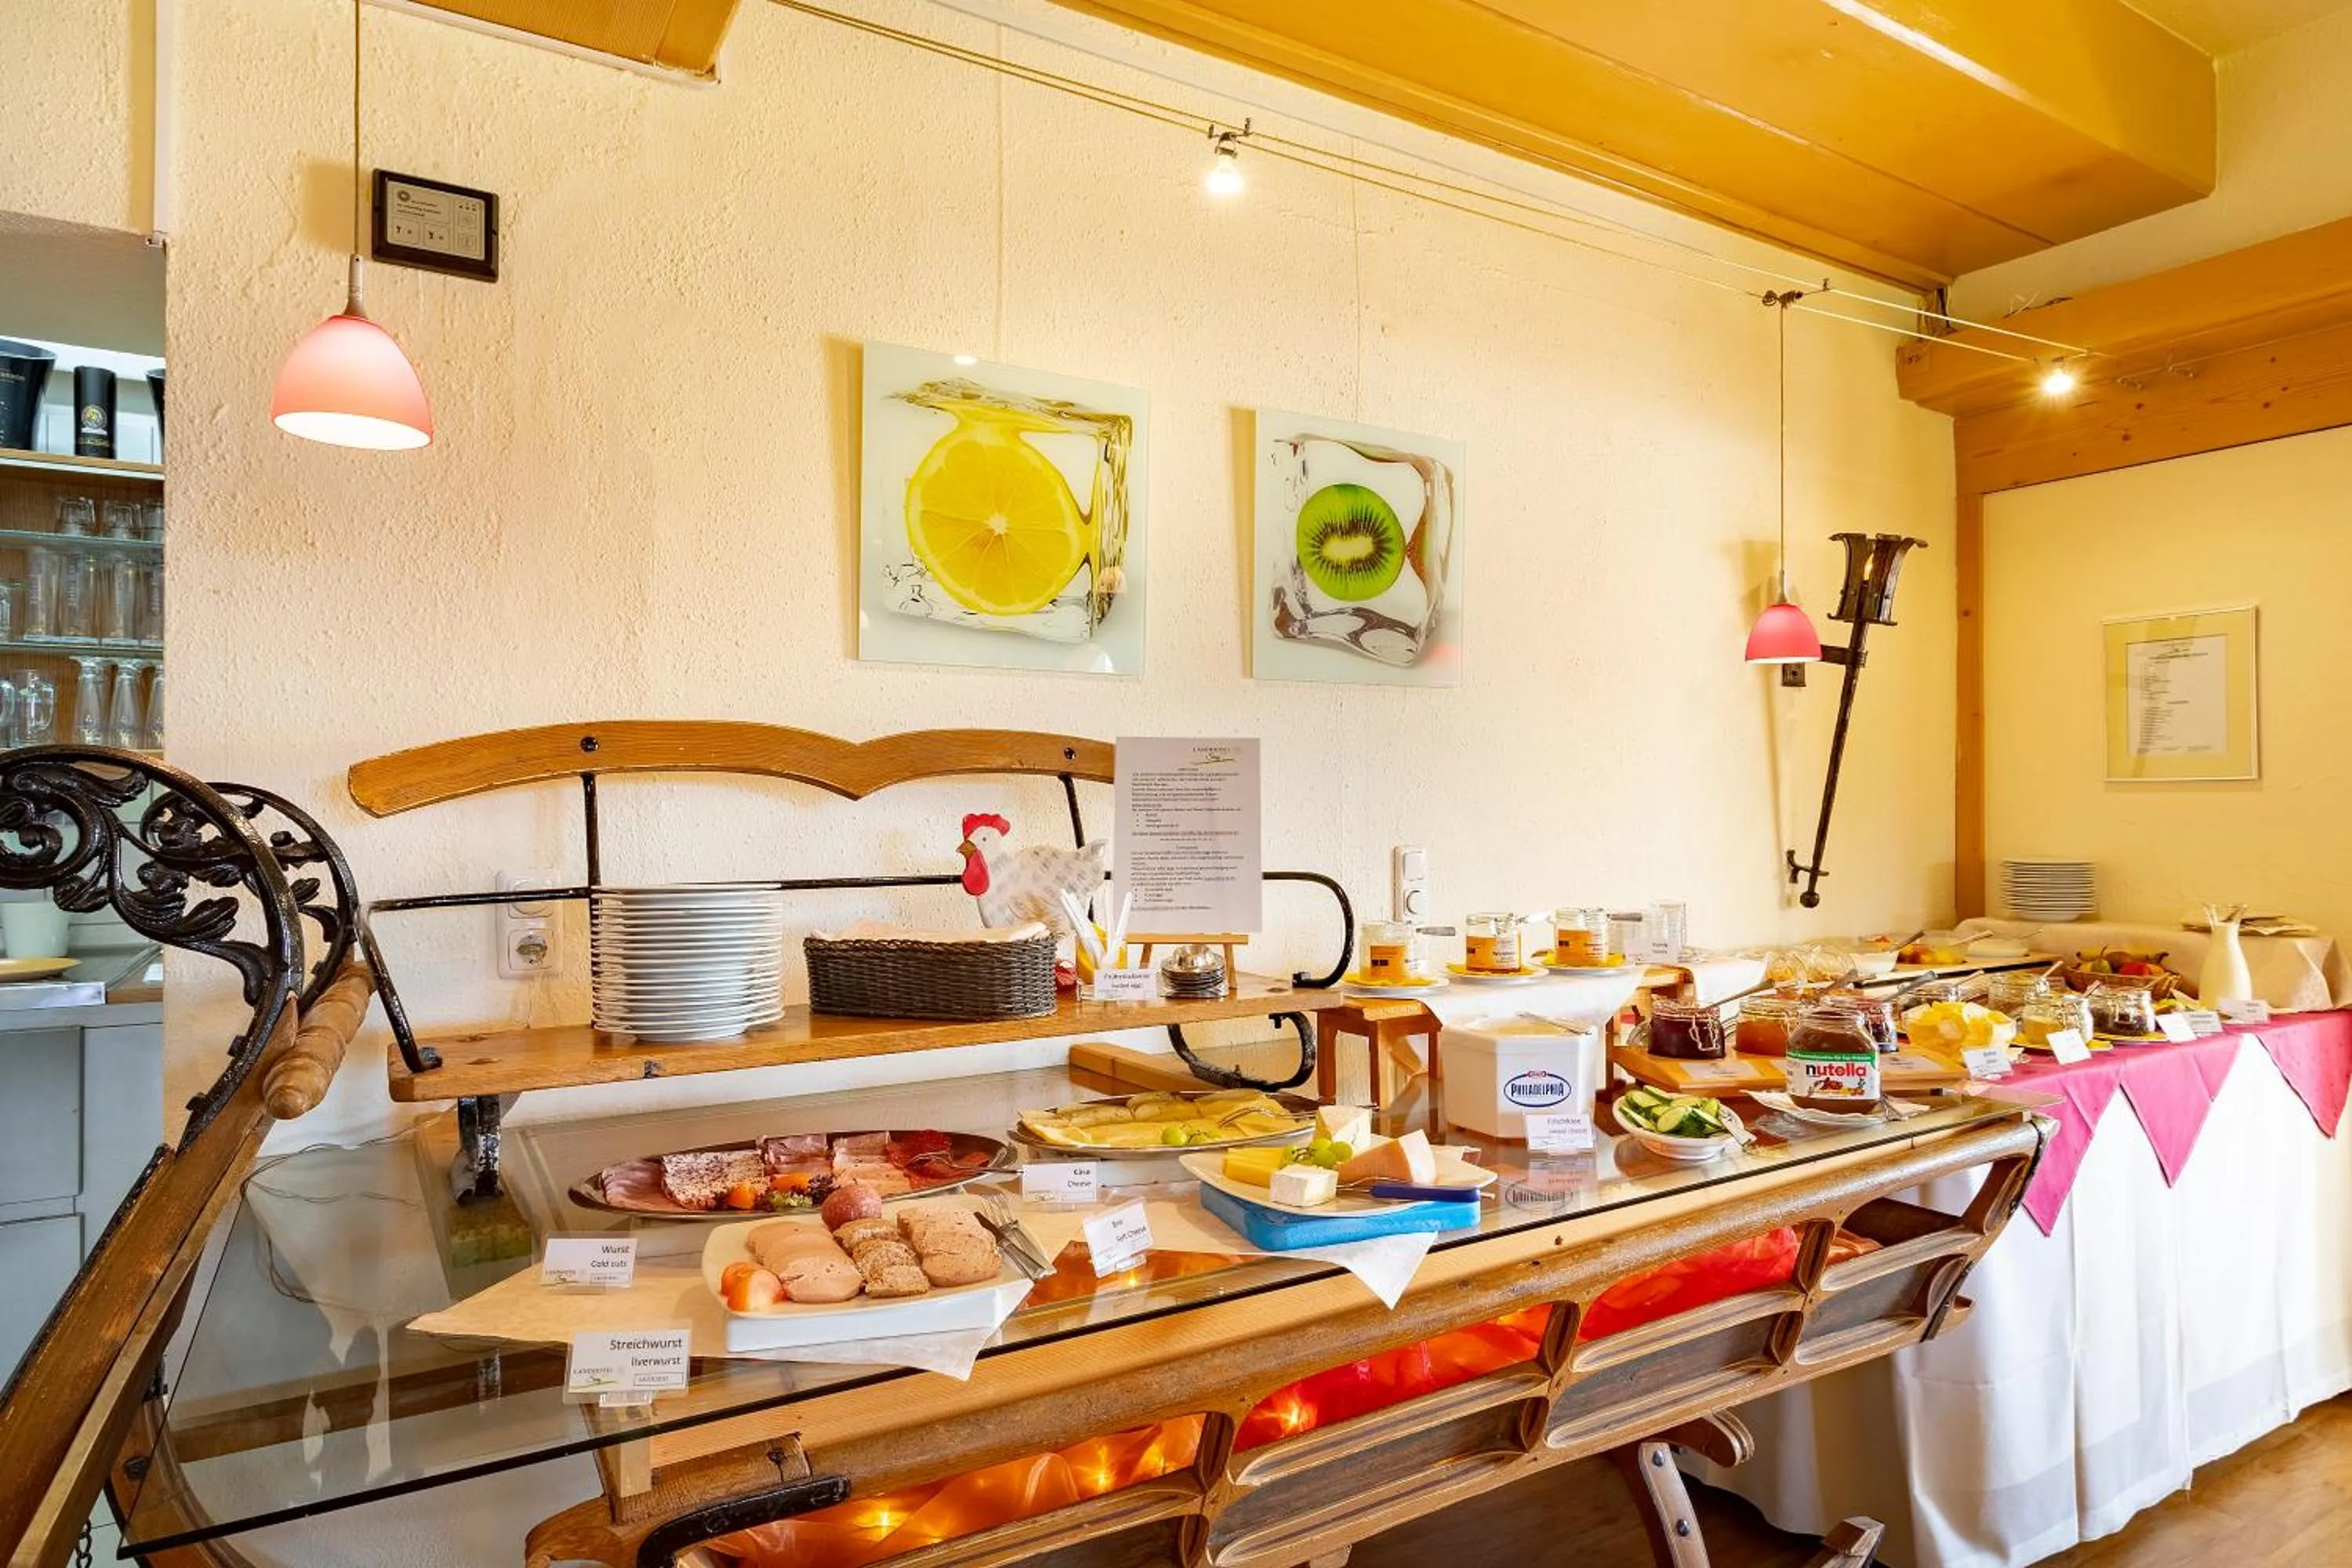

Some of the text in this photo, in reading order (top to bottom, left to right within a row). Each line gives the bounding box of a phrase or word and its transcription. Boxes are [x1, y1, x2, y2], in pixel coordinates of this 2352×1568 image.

[1806, 1063, 1867, 1076] nutella
[1511, 1082, 1564, 1098] PHILADELPHIA
[601, 1246, 630, 1254] Wurst
[609, 1338, 684, 1351] Streichwurst
[630, 1356, 681, 1367] liverwurst
